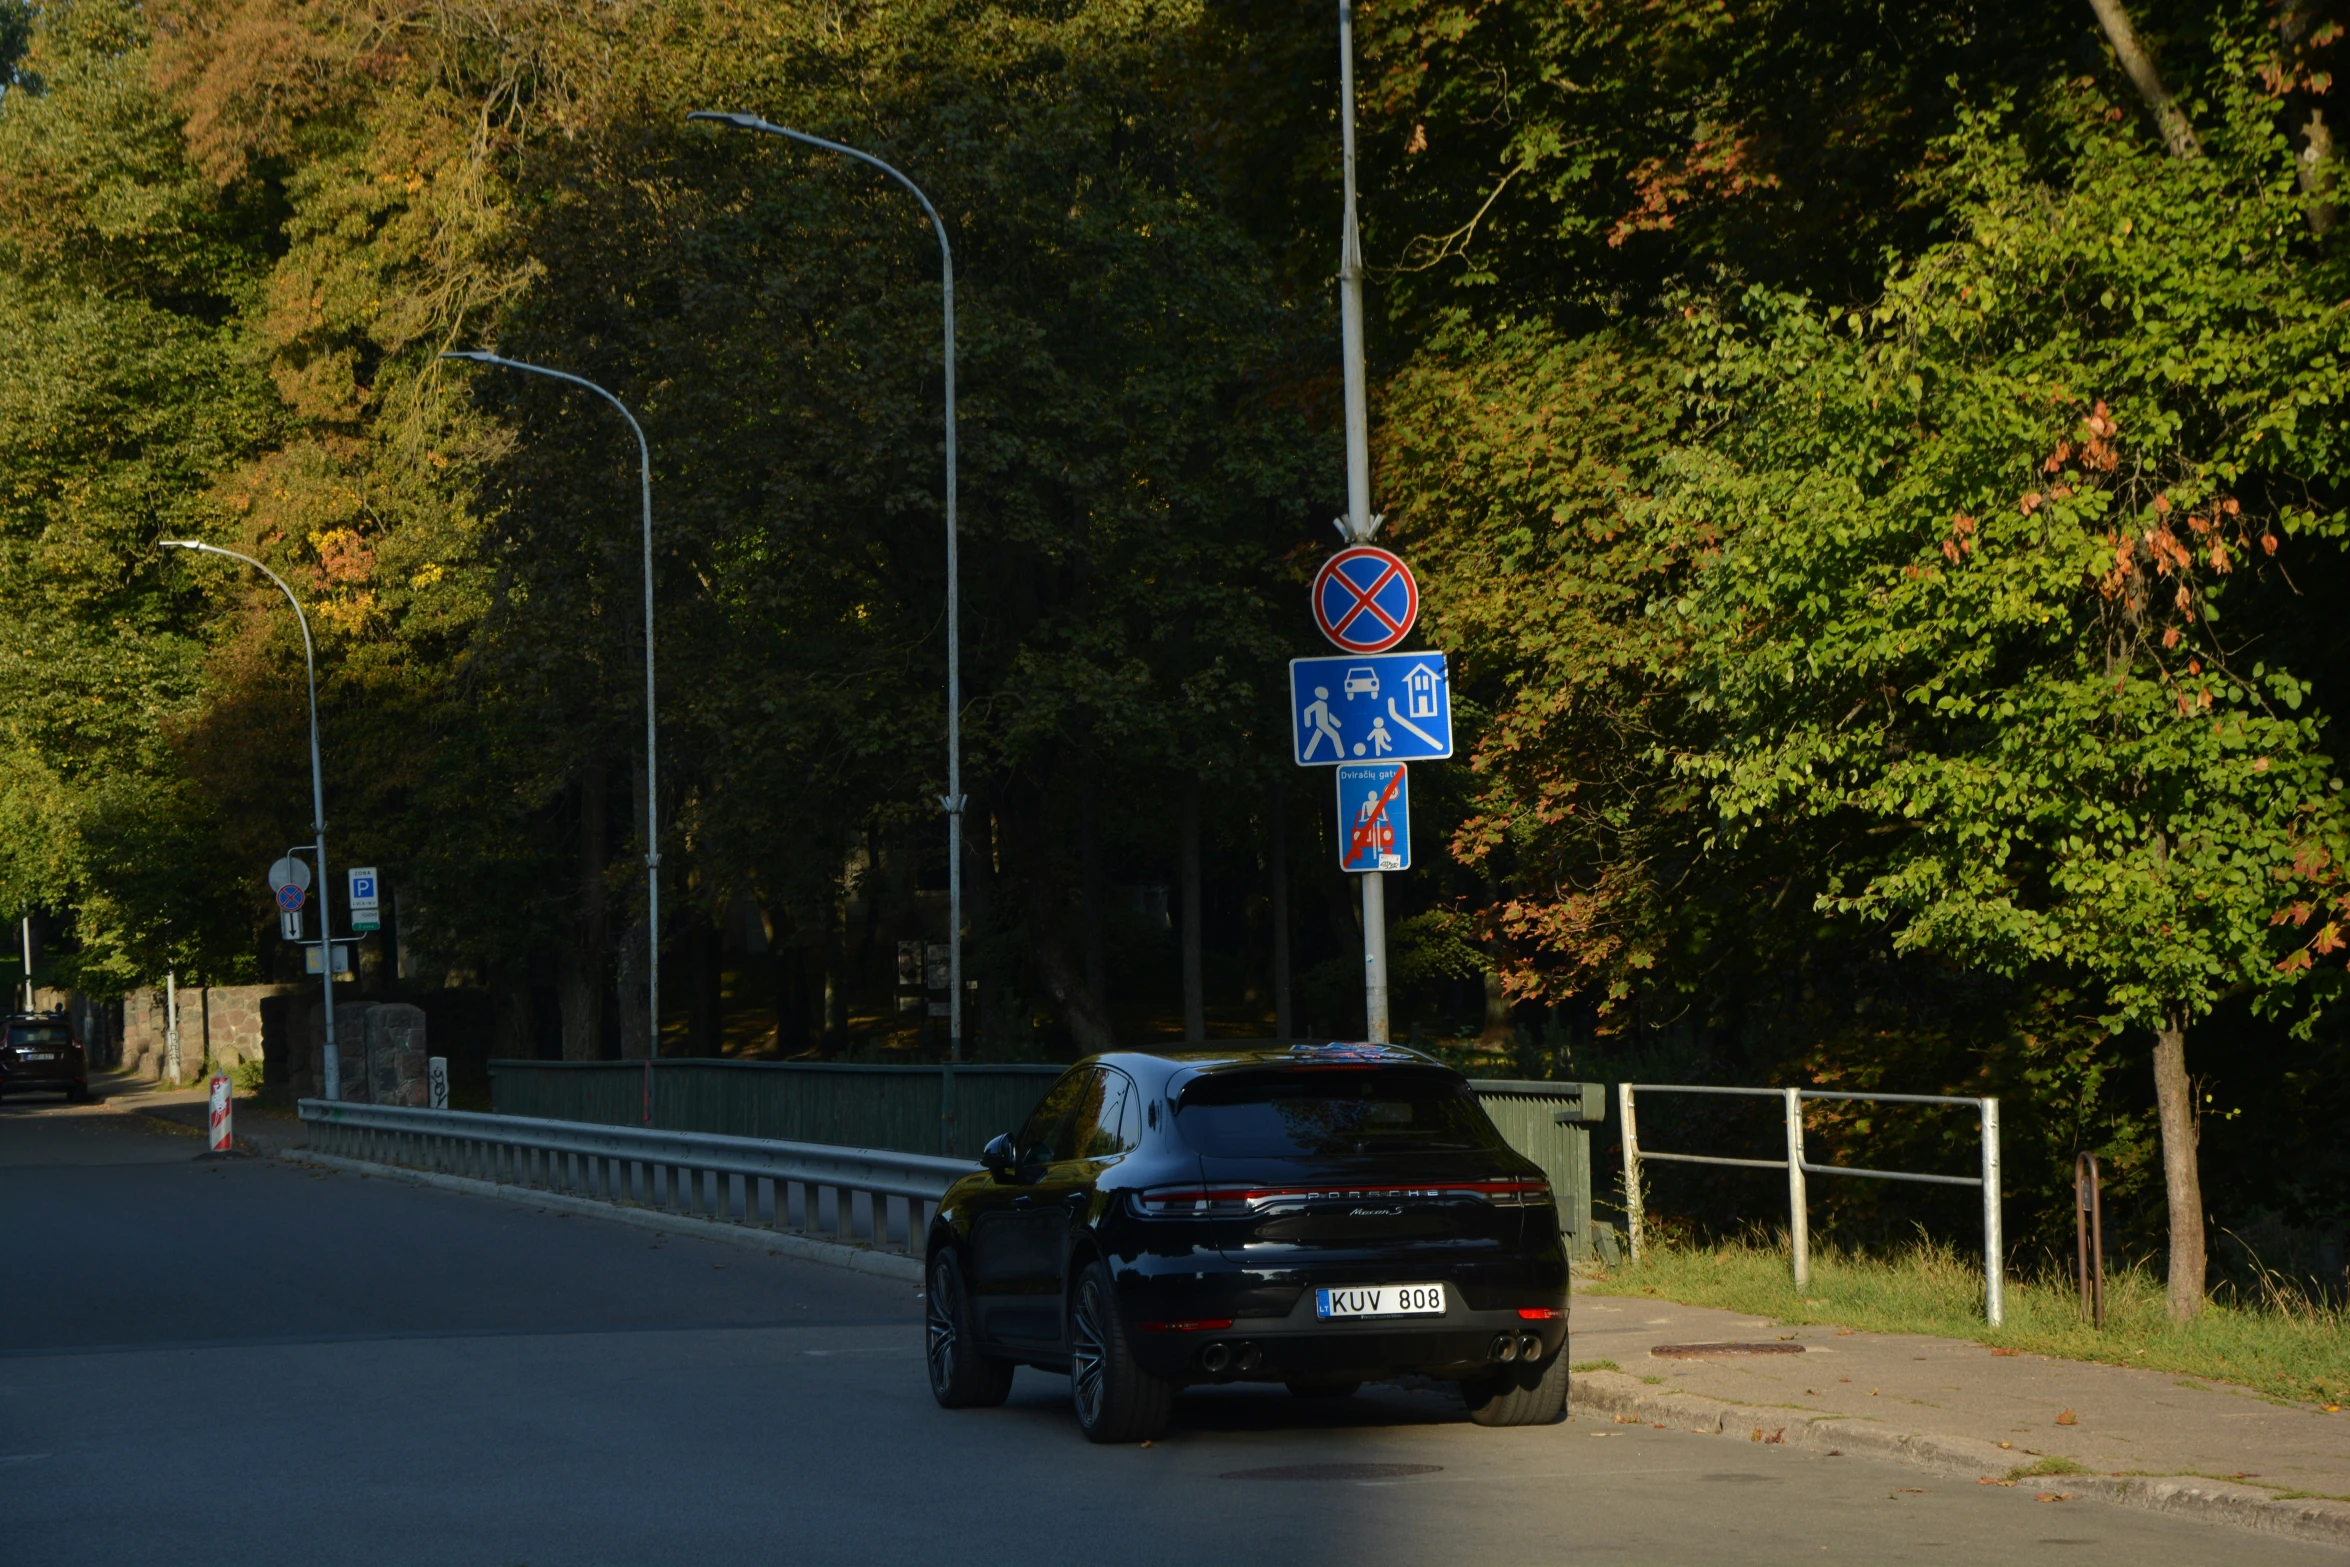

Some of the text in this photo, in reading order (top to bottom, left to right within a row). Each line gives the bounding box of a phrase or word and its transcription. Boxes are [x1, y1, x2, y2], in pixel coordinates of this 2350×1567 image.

[1341, 770, 1376, 780] Dviračių
[357, 880, 369, 896] P
[1308, 1190, 1439, 1199] PORSCHE
[1349, 1206, 1404, 1216] Macan S
[1332, 1288, 1440, 1313] KUV 808
